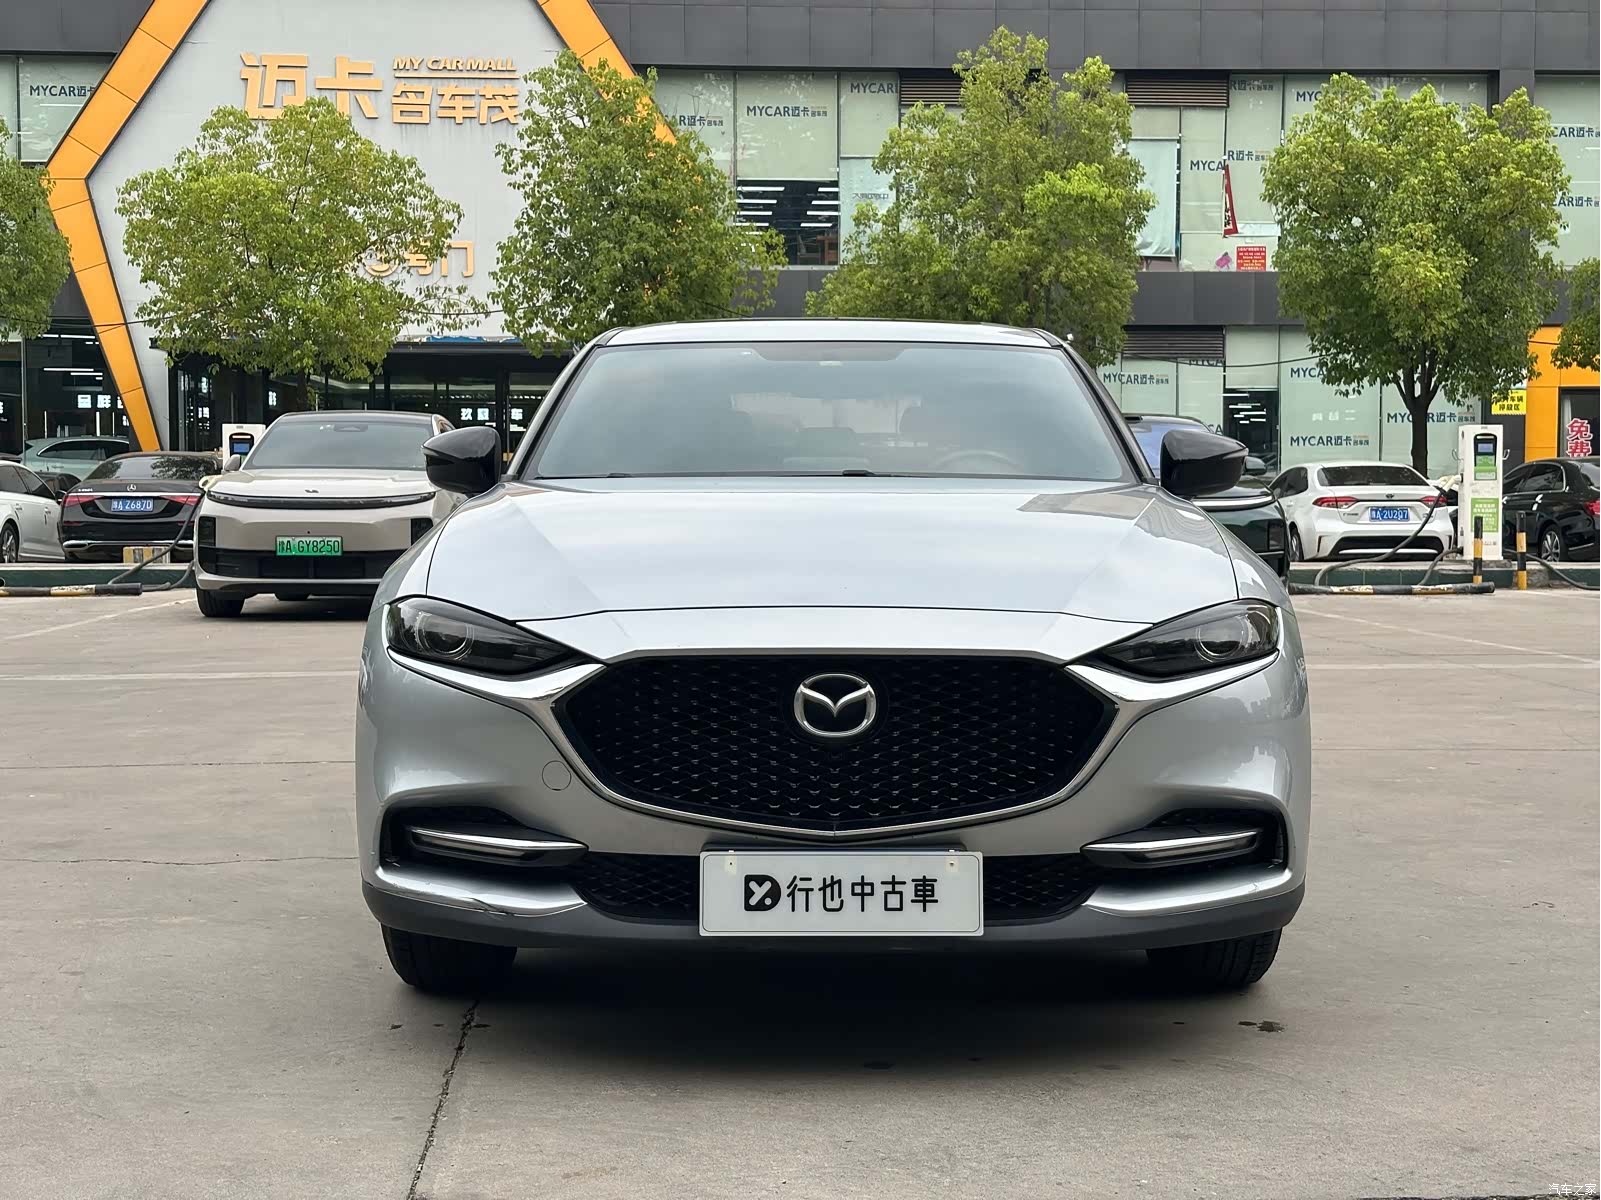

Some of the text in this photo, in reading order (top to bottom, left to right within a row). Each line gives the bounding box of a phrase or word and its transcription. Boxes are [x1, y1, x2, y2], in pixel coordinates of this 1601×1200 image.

[392, 56, 517, 71] MY CAR MALL
[240, 51, 384, 120] 迈卡
[850, 82, 898, 94] MYCAR
[391, 83, 521, 125] 名车茂
[1387, 412, 1457, 423] MYCR迈卡
[786, 874, 939, 913] 行也中古車
